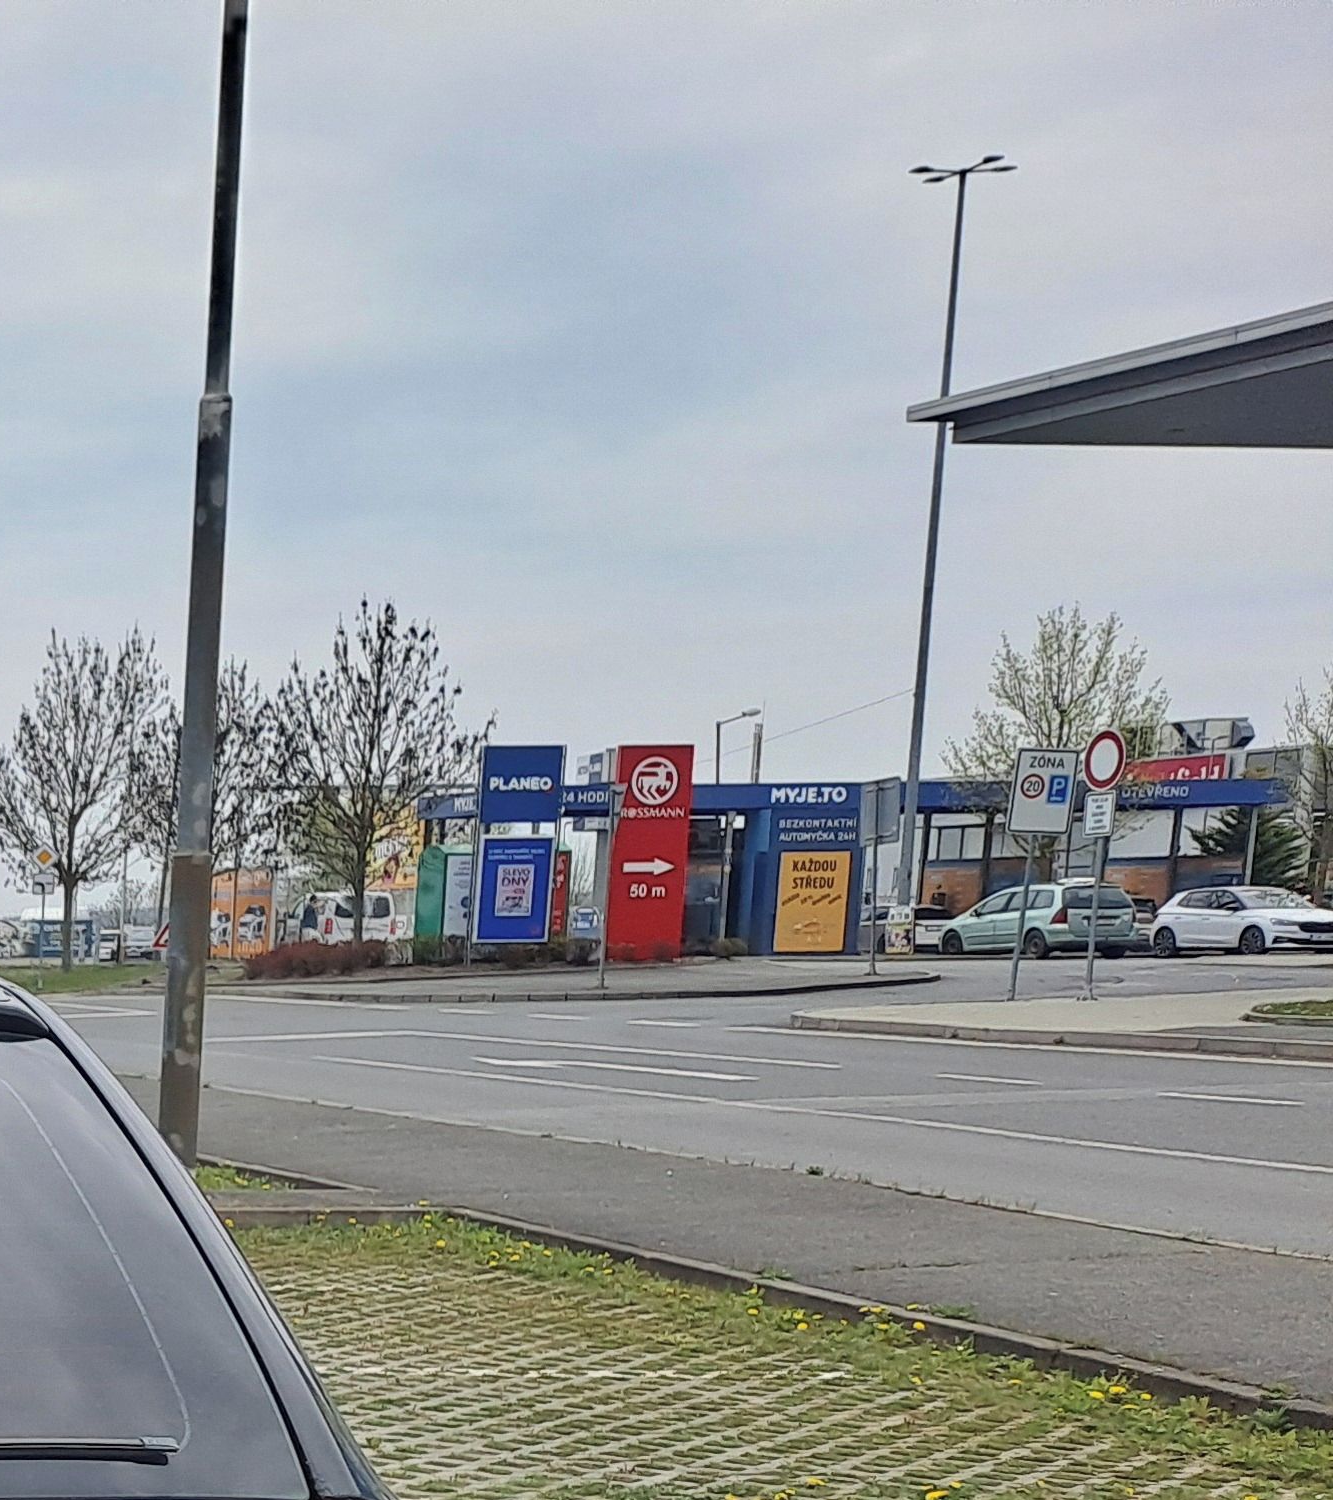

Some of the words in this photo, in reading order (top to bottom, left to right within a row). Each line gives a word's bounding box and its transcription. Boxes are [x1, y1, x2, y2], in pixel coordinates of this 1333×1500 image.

[1028, 754, 1065, 769] ZÓNA
[489, 776, 553, 792] PLANEO
[1025, 781, 1041, 793] 20
[770, 786, 847, 804] MYJE.TO
[620, 806, 685, 819] ROSSMANN
[779, 817, 857, 829] BEZKONTAKTNÍ
[778, 830, 835, 842] AUTOMYČKA
[792, 858, 837, 873] KAŽDOU
[501, 876, 530, 887] DNY
[791, 875, 835, 889] STŘEDU
[629, 883, 648, 898] 50
[651, 886, 666, 898] m
